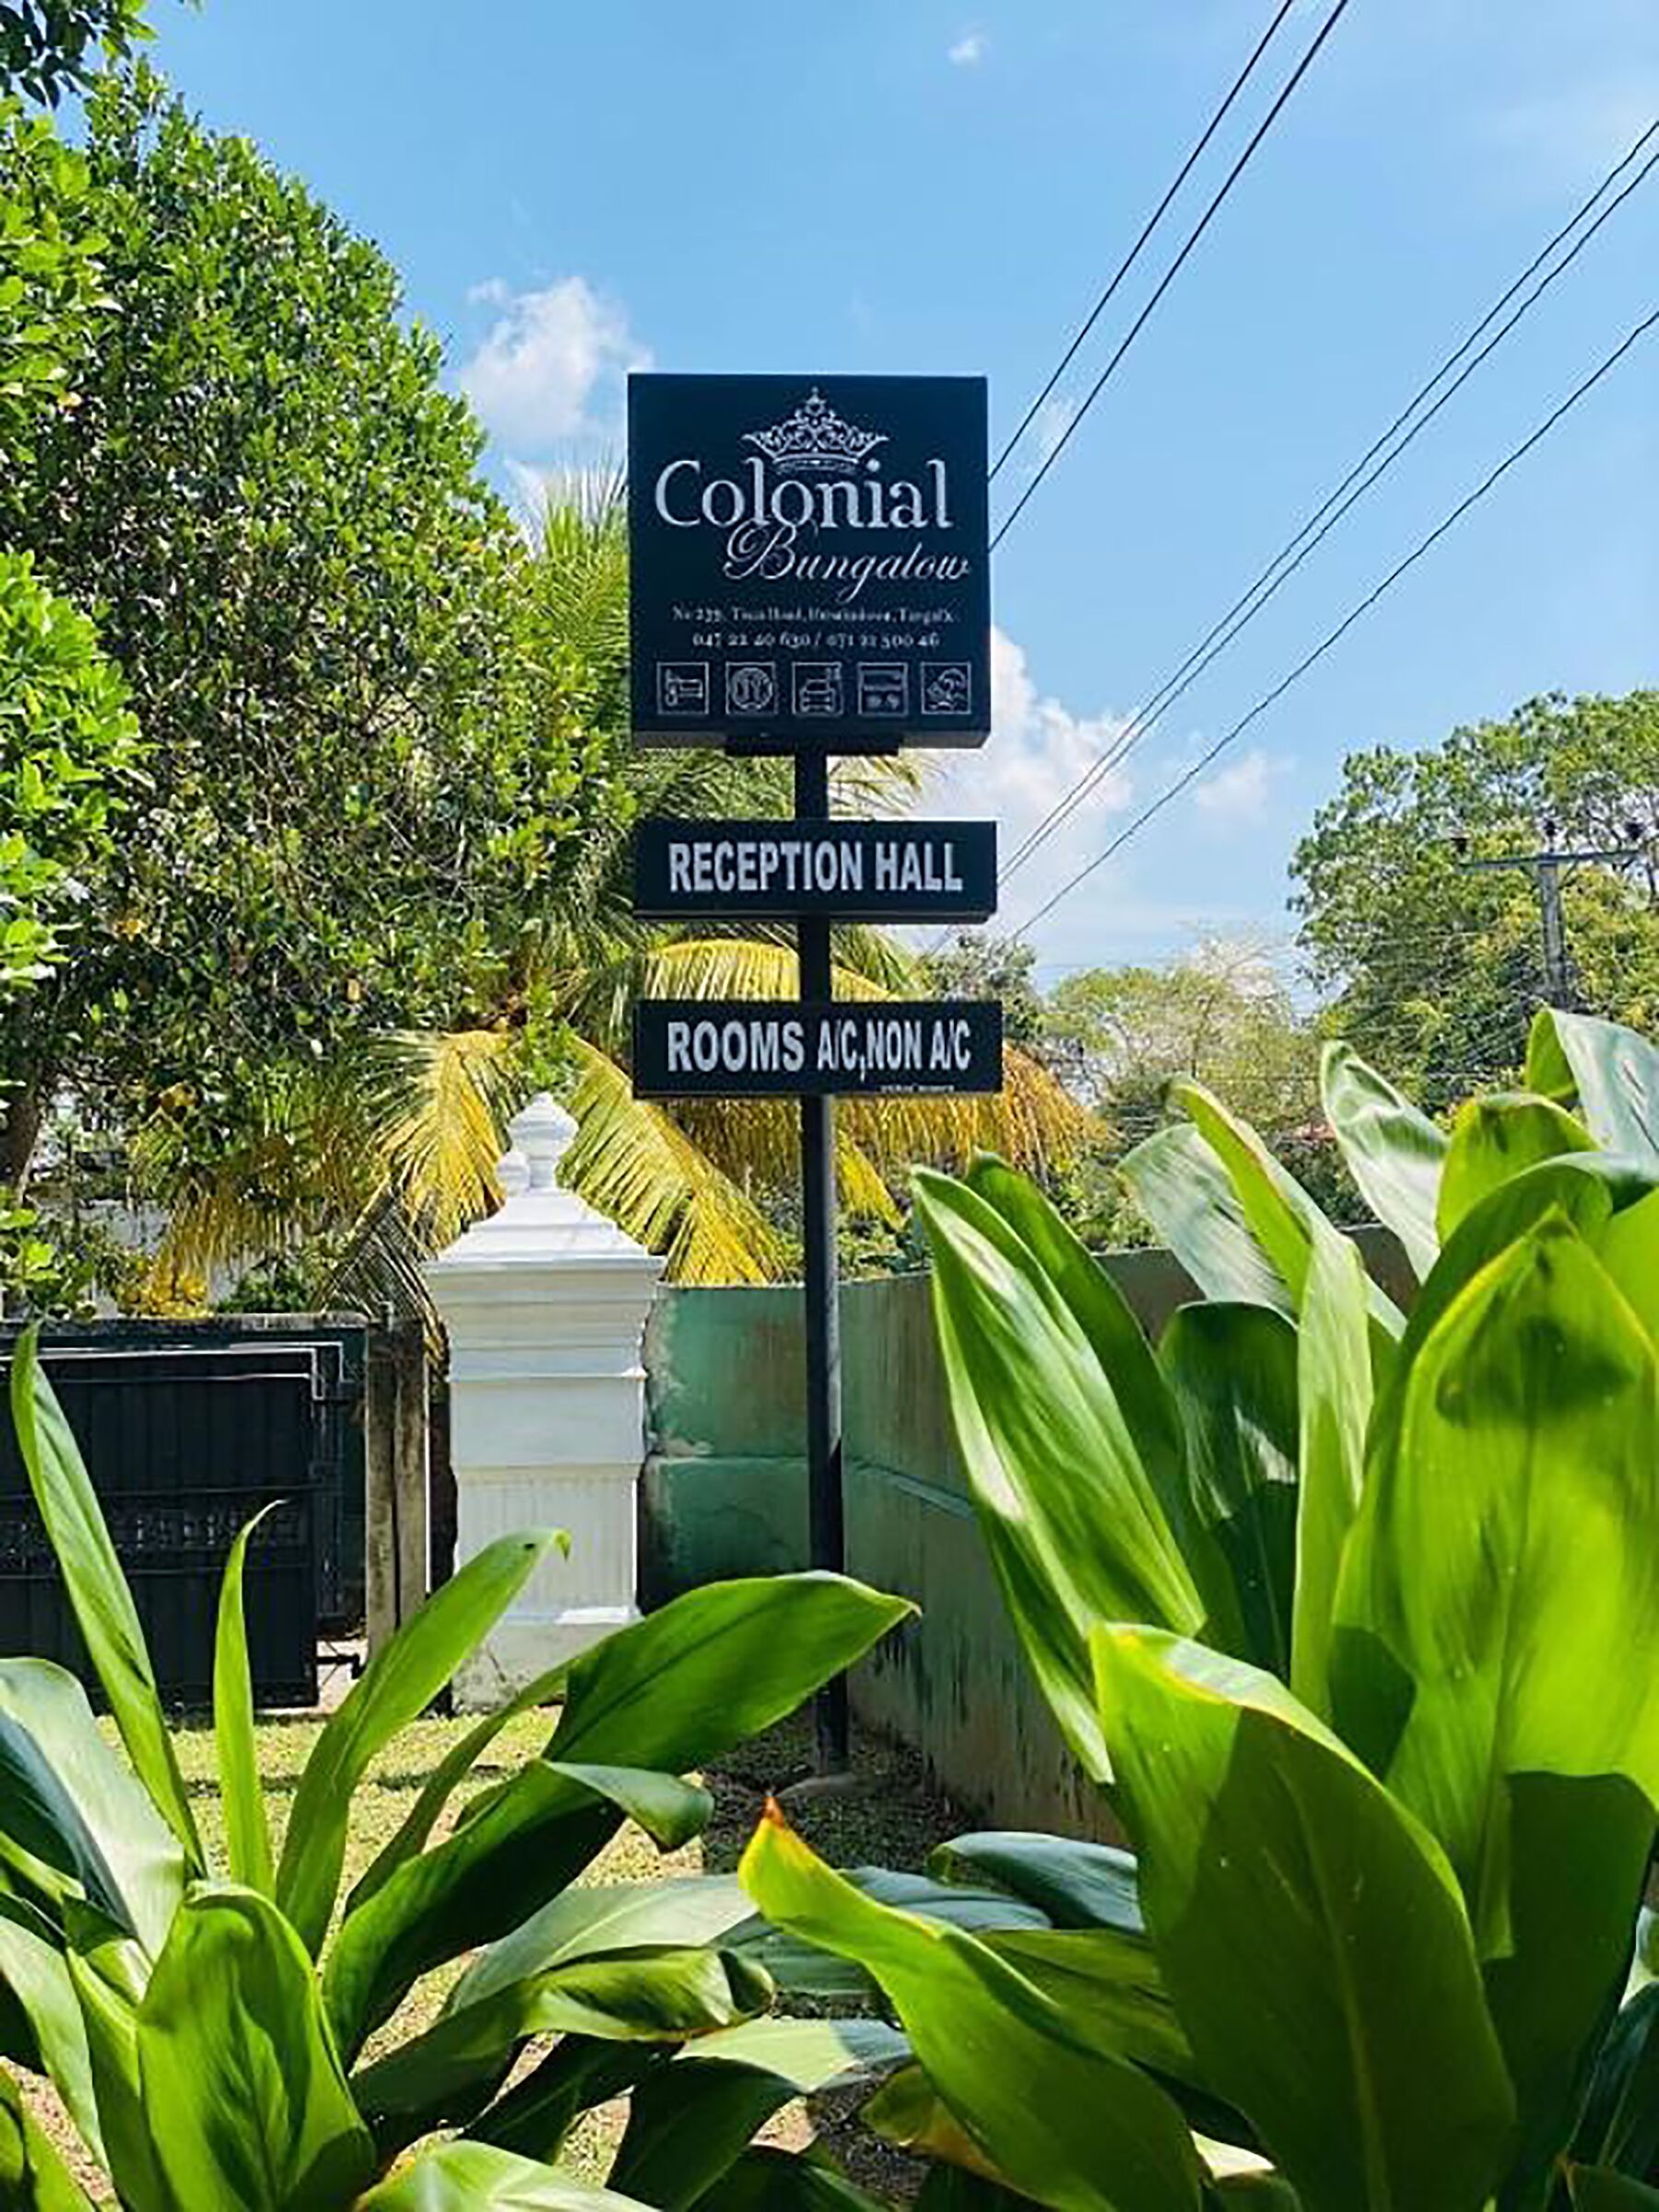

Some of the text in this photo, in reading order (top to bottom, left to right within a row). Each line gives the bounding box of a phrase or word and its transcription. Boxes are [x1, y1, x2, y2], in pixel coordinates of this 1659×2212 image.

[655, 457, 954, 530] Colonial
[724, 519, 970, 603] Bungalow
[668, 841, 963, 893] RECEPTION HALL
[667, 1020, 805, 1072] ROOMS
[929, 1019, 971, 1072] A/C
